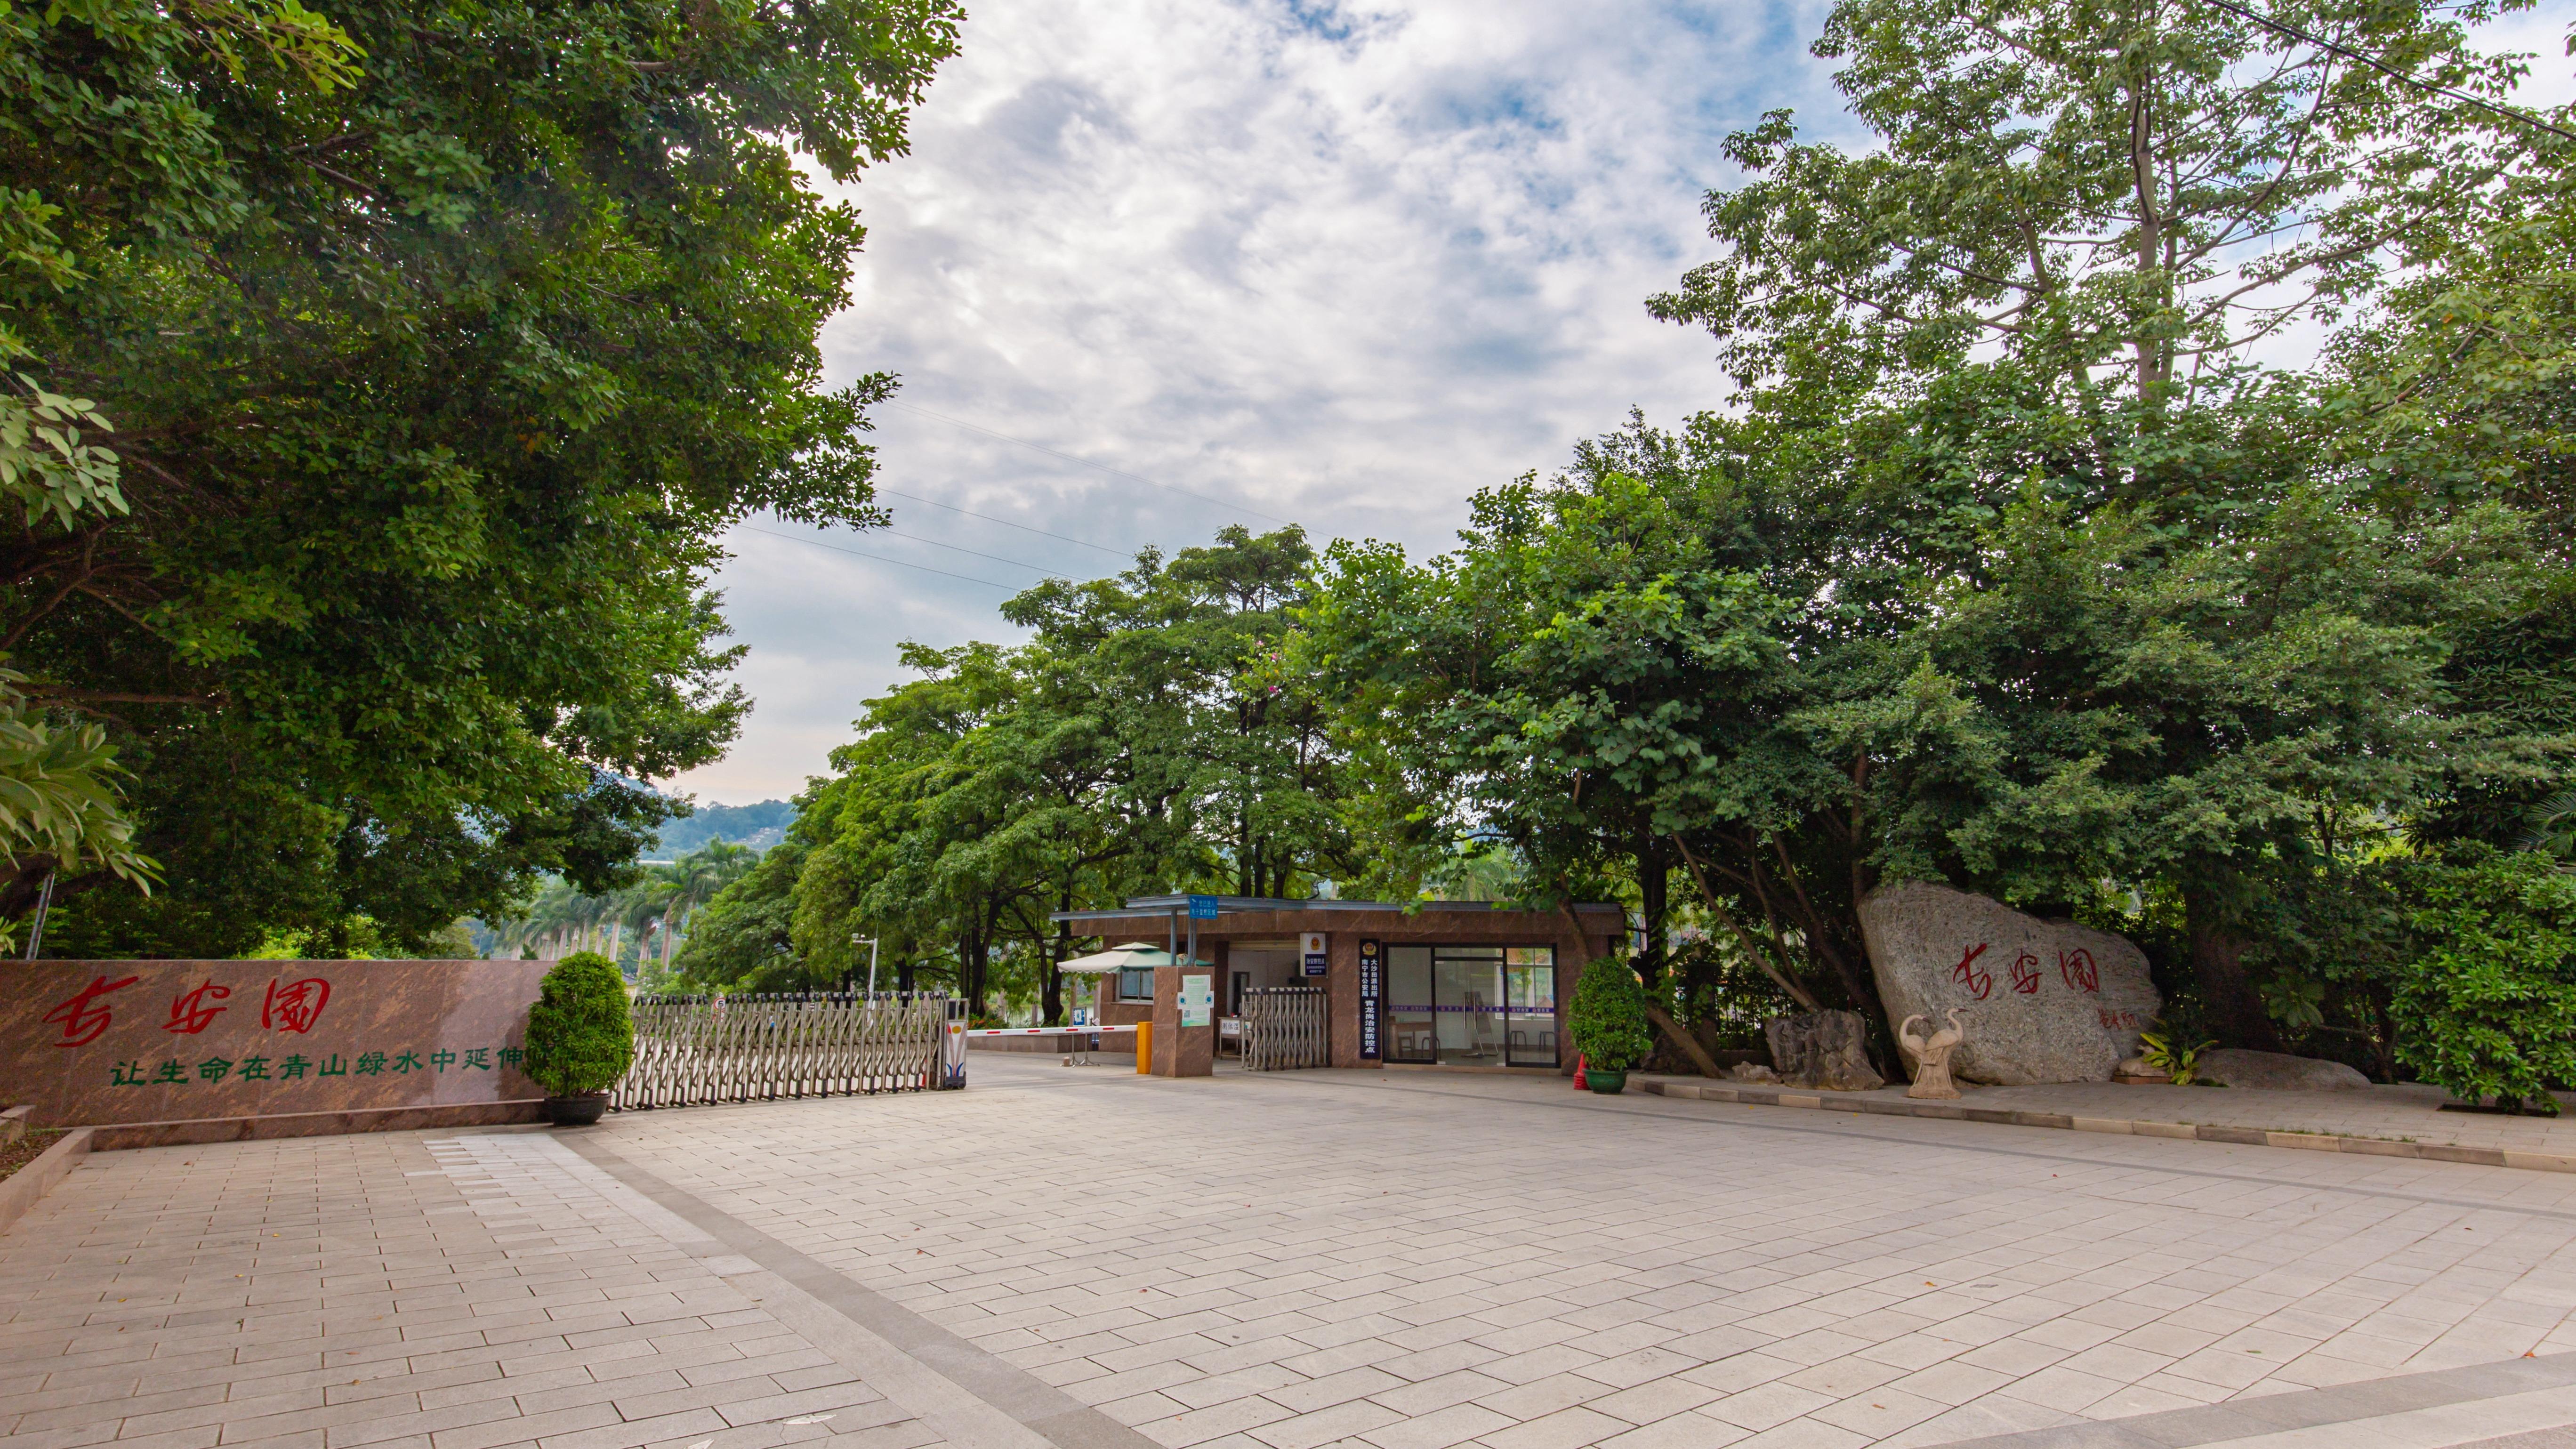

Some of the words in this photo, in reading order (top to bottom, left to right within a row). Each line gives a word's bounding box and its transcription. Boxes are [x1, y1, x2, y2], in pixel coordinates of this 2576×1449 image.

[1222, 1022, 1239, 1030] 测体温
[1364, 1000, 1376, 1053] 青龙岗治安防控点
[110, 1046, 523, 1087] 让生命在青山绿水中延伸
